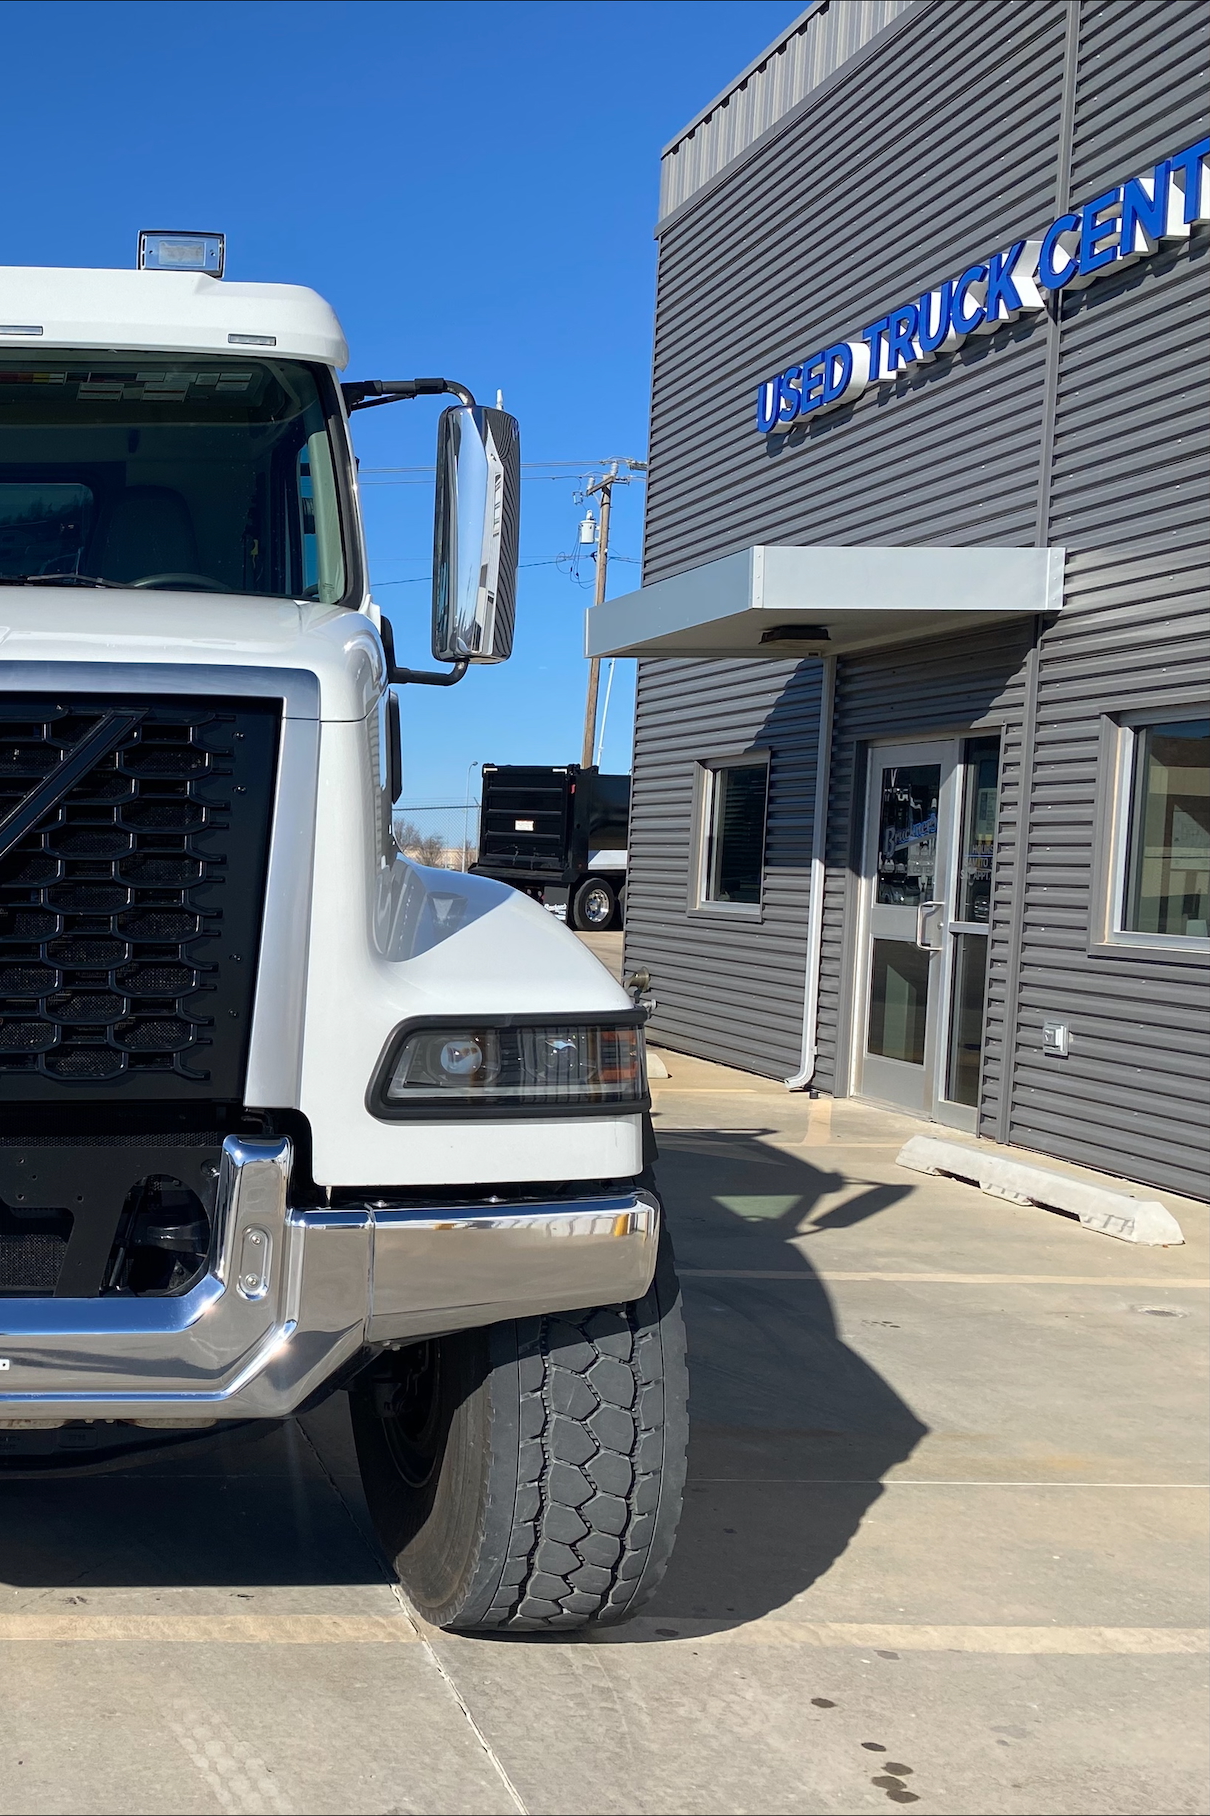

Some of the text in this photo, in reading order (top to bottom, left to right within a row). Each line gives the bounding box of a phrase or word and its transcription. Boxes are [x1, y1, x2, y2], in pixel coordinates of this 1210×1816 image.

[756, 341, 856, 434] USED
[863, 240, 1028, 382] TRUCK
[883, 812, 938, 858] Bruckner's
